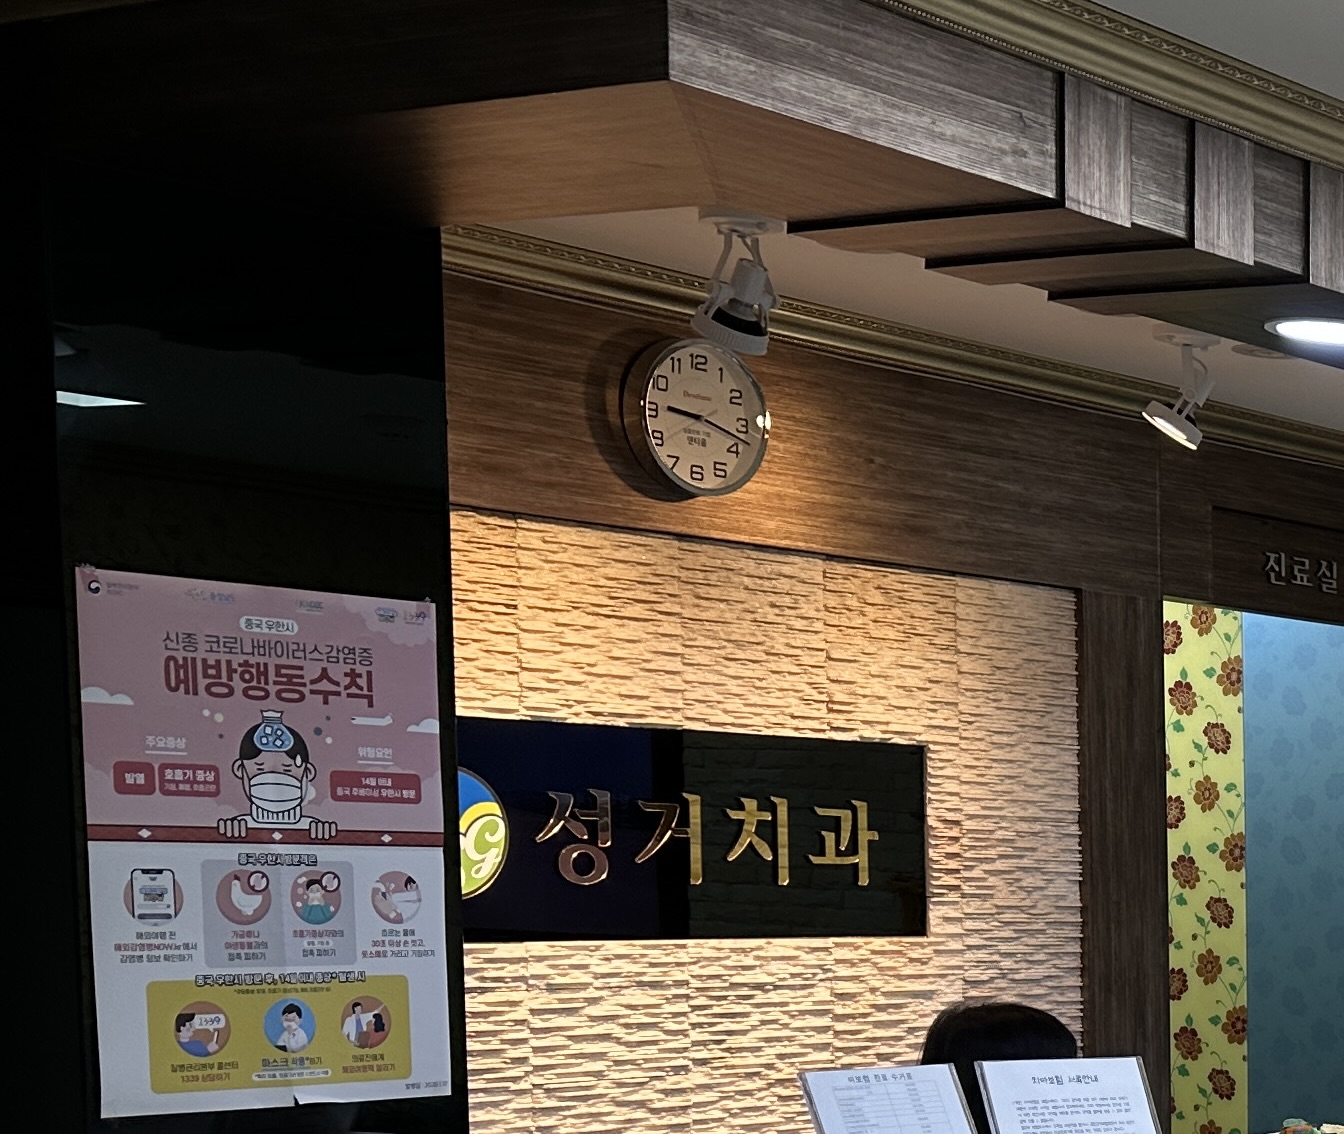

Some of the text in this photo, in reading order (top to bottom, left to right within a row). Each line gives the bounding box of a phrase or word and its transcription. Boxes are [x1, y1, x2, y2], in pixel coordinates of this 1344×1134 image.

[670, 357, 681, 374] 11
[689, 353, 708, 372] 12
[652, 374, 668, 392] 10
[718, 367, 724, 383] 1
[729, 389, 742, 406] 2
[736, 418, 748, 434] 3
[727, 442, 740, 458] 4
[666, 454, 680, 470] 7
[713, 461, 727, 478] 5
[690, 464, 704, 481] 6
[1263, 550, 1339, 594] 진료실
[244, 618, 295, 633] 중국 우한시
[163, 631, 374, 667] 신종 코로나바이러스감염증
[163, 654, 375, 708] 예방행동수칙
[535, 788, 879, 888] 성거치과
